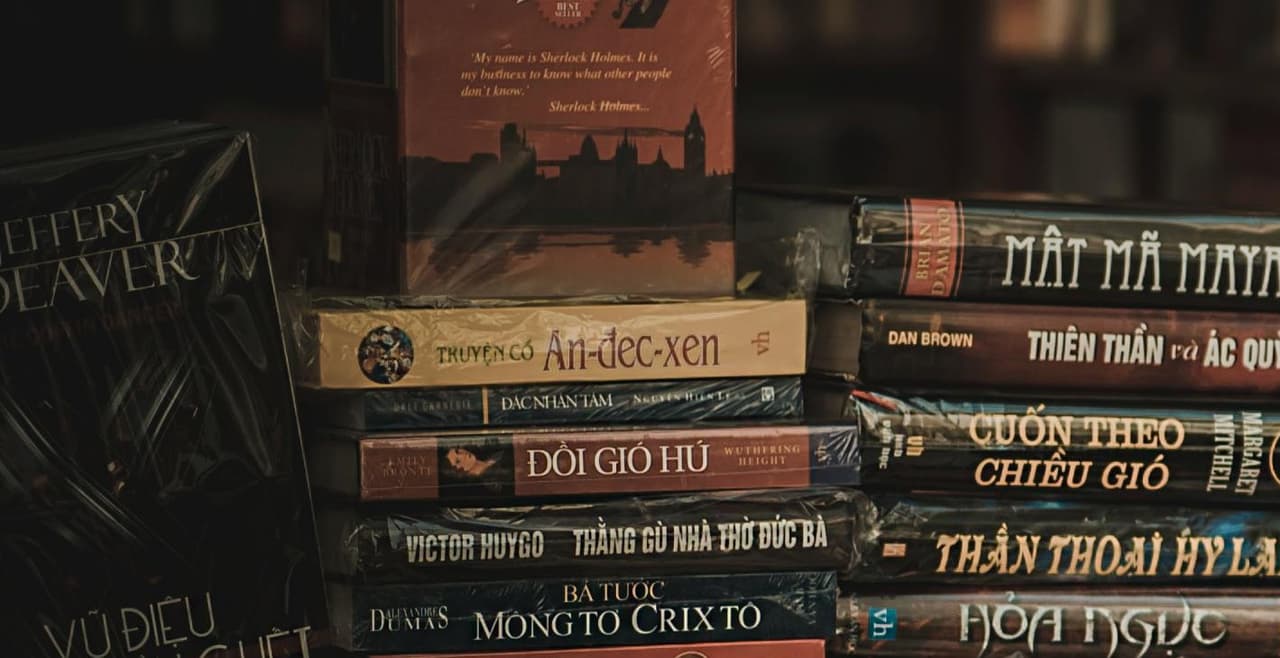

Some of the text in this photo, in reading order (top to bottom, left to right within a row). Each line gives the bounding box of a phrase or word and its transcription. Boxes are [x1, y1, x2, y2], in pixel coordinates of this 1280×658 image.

[460, 71, 478, 82] my
[530, 70, 541, 80] to
[543, 69, 571, 80] know
[575, 68, 602, 80] what
[604, 68, 632, 80] other
[634, 68, 673, 82] people
[494, 55, 525, 64] name
[527, 51, 537, 64] is
[539, 51, 587, 64] Sherlock
[637, 51, 647, 62] It
[648, 51, 659, 62] is
[547, 100, 598, 112] Sherlock
[0, 190, 143, 268] EFFERY
[916, 222, 931, 281] BRIAN
[1100, 229, 1162, 292] MÃ
[887, 329, 974, 349] DAN BROWN
[1027, 324, 1097, 363] THIÊN
[1101, 321, 1165, 367] THẦN
[1170, 339, 1199, 361] và
[1203, 328, 1238, 369] ÁC
[723, 444, 800, 456] WUTHERING
[967, 403, 1186, 453] CUỐN THEO
[526, 440, 711, 477] ĐỒI GIÓ HÚ
[738, 456, 786, 466] HEIGHT
[973, 444, 1170, 491] CHIỀU GIÓ
[1205, 413, 1235, 493] MITCHELL
[1234, 410, 1264, 496] MARGARET
[406, 530, 544, 563] VICTOR HUYGO
[572, 513, 828, 557] THẰNG GÙ NHÀ THỜ ĐỨC BÀ
[935, 521, 1042, 576] THẦN
[370, 605, 448, 632] DUMAS
[872, 608, 894, 638] vh
[959, 591, 1227, 658] HỎA NGỤC
